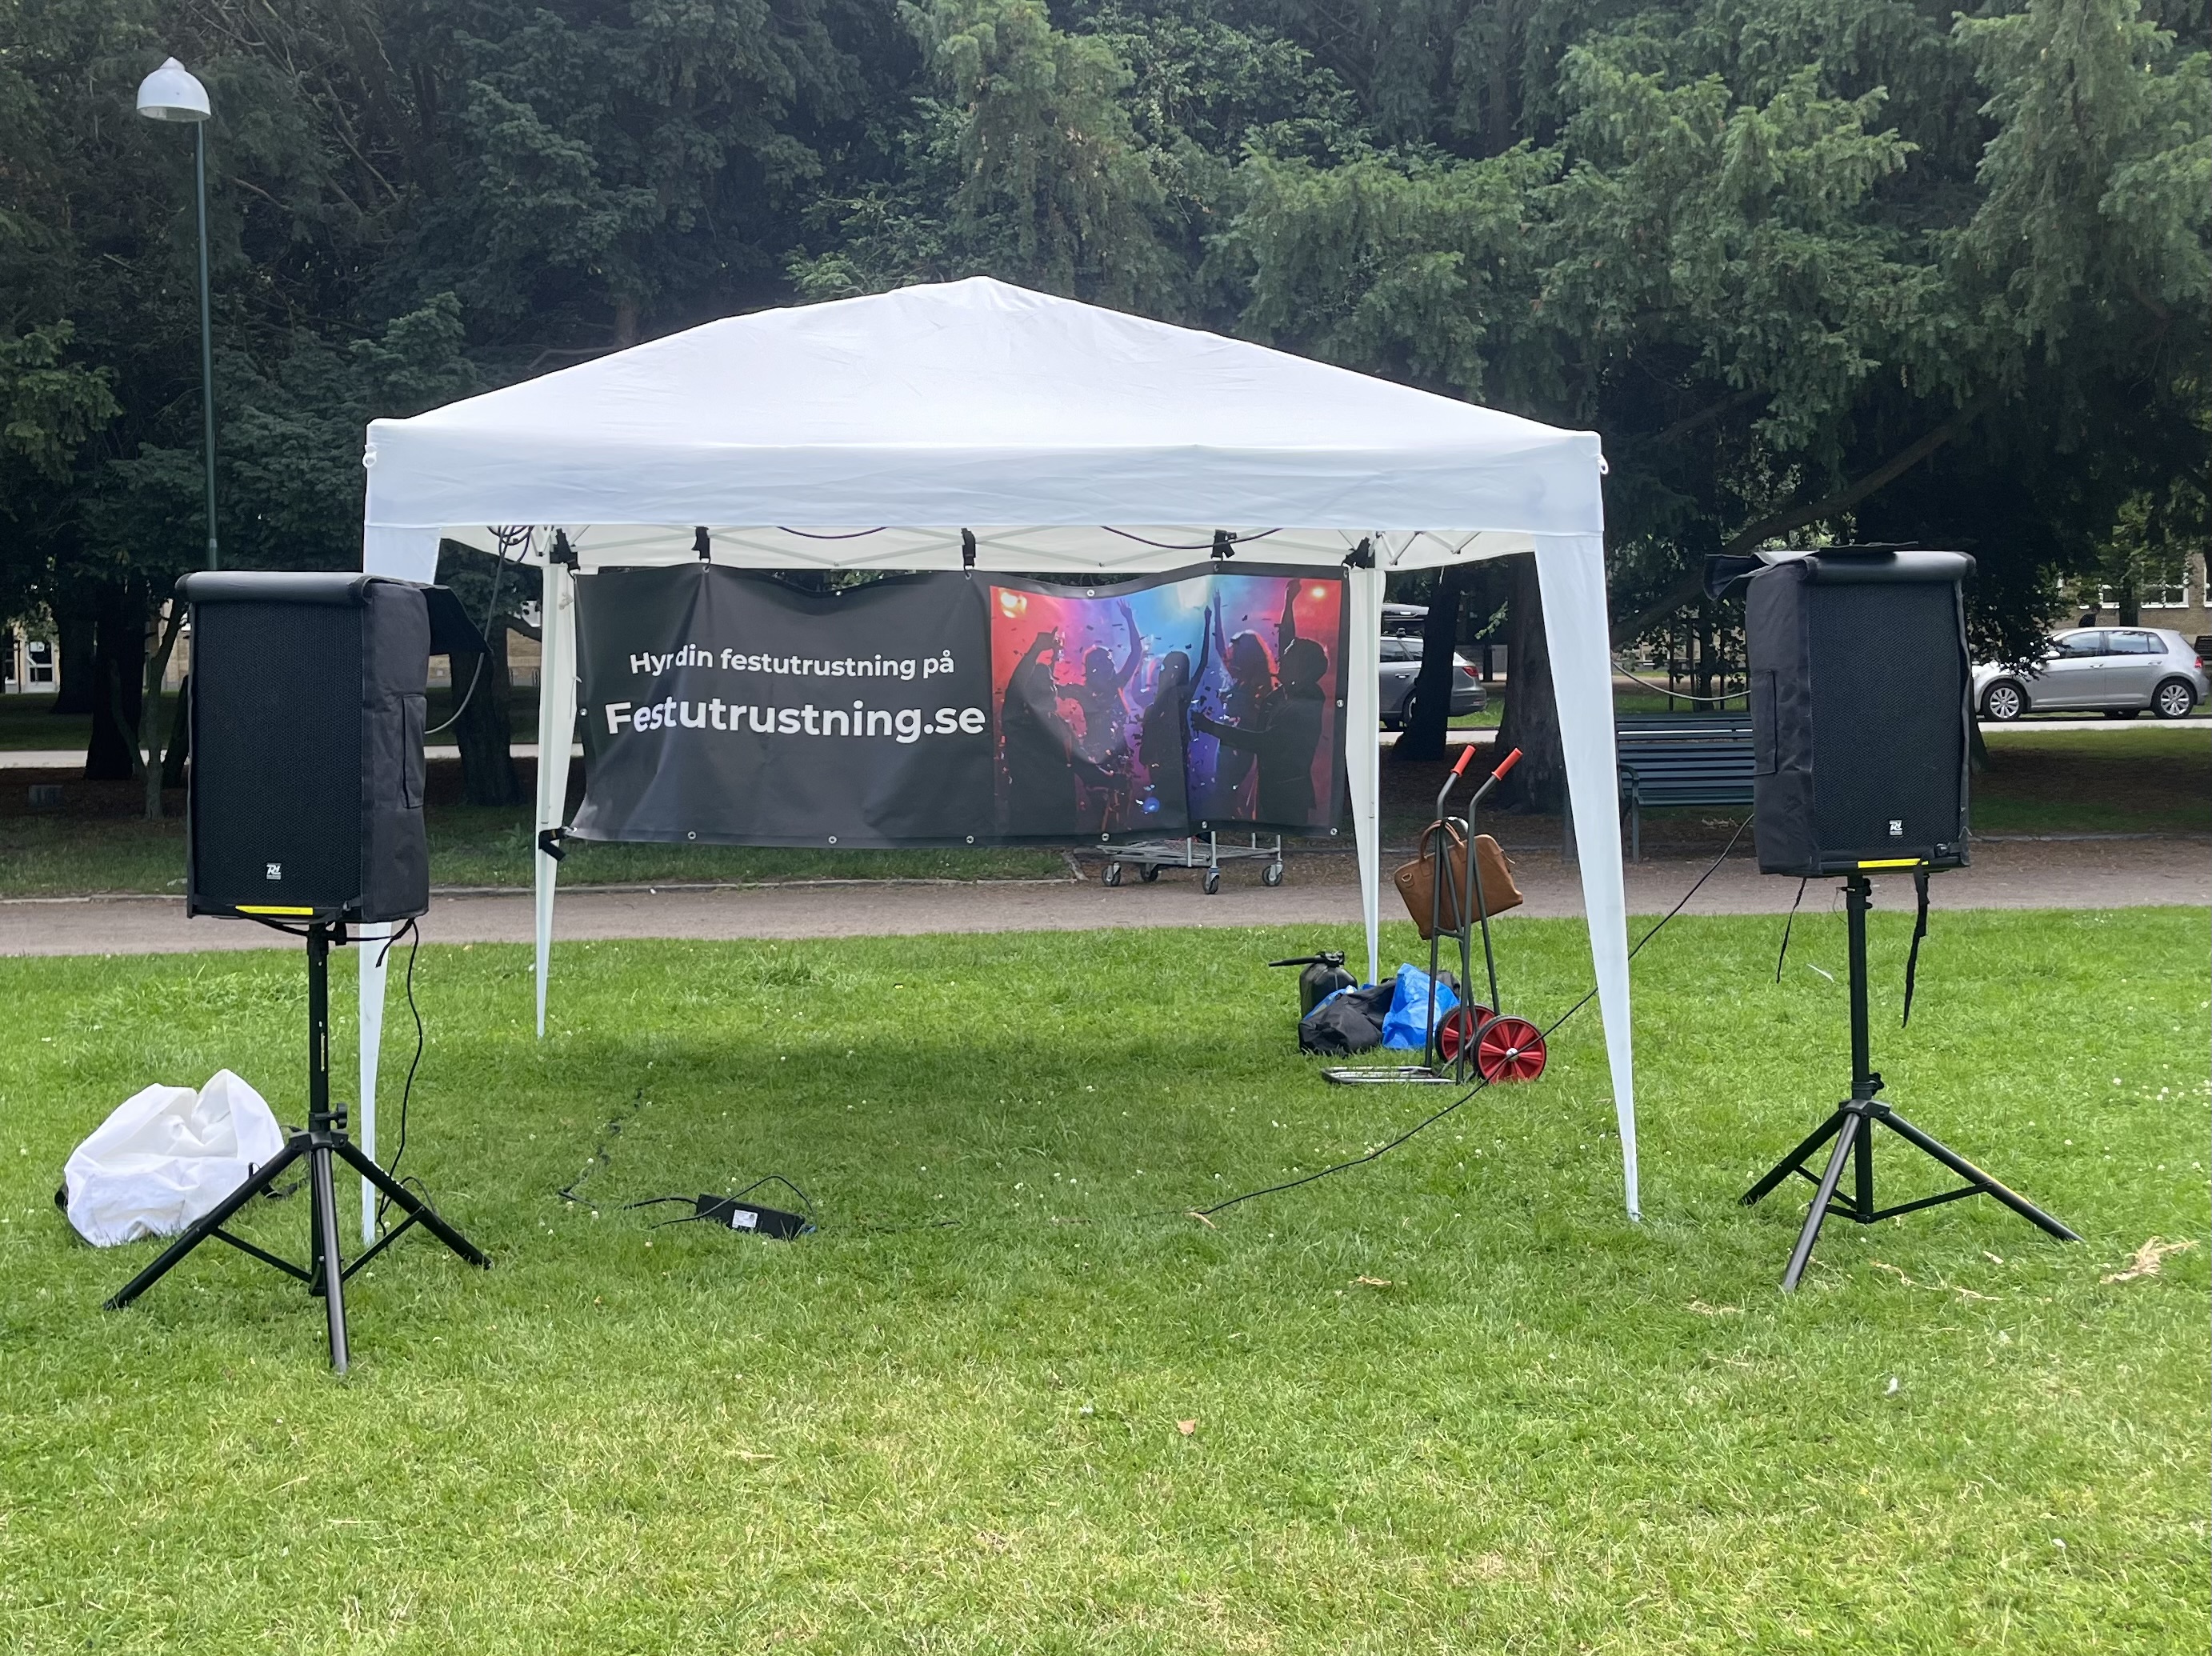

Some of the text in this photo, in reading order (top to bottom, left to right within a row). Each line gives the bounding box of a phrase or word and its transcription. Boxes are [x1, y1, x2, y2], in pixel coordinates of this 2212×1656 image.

[720, 648, 916, 681] festutrustning
[922, 649, 954, 679] på
[605, 696, 986, 744] Festutrustning.se
